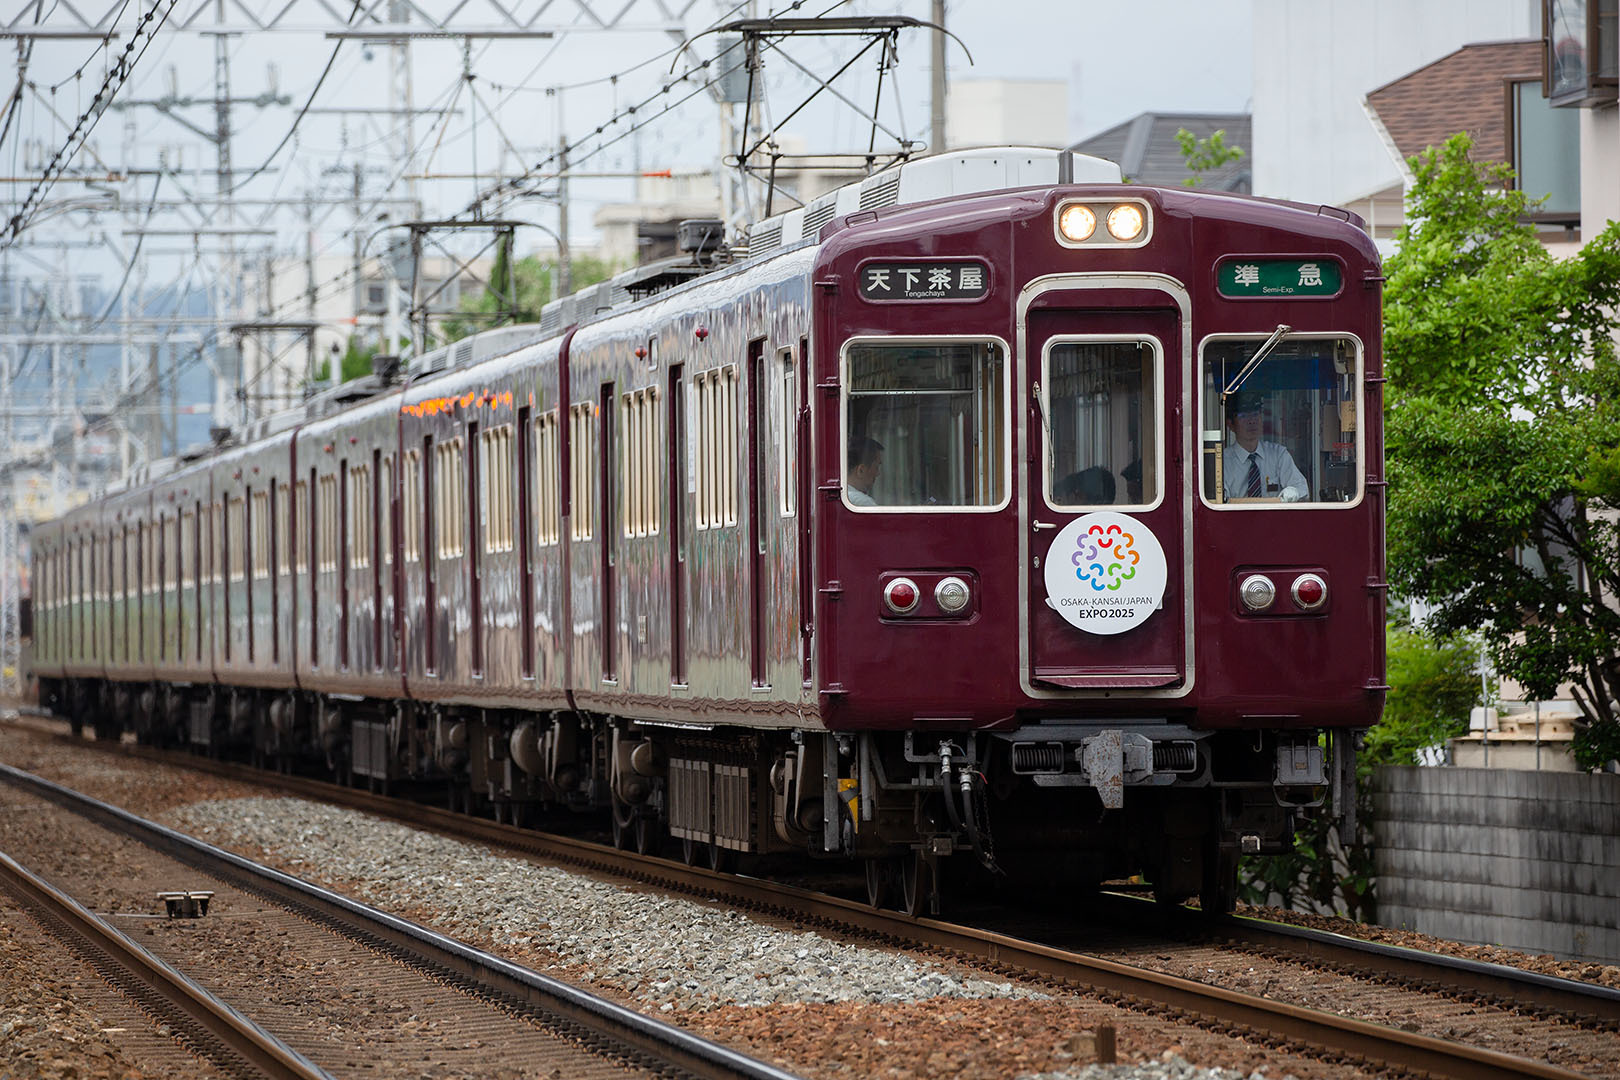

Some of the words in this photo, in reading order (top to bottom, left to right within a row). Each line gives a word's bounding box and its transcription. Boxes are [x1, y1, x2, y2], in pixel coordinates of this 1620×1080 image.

[867, 267, 983, 292] 天下茶屋
[1234, 263, 1323, 287] 準急
[904, 290, 946, 298] Tengachaya
[1262, 286, 1294, 294] Semi-Exp.
